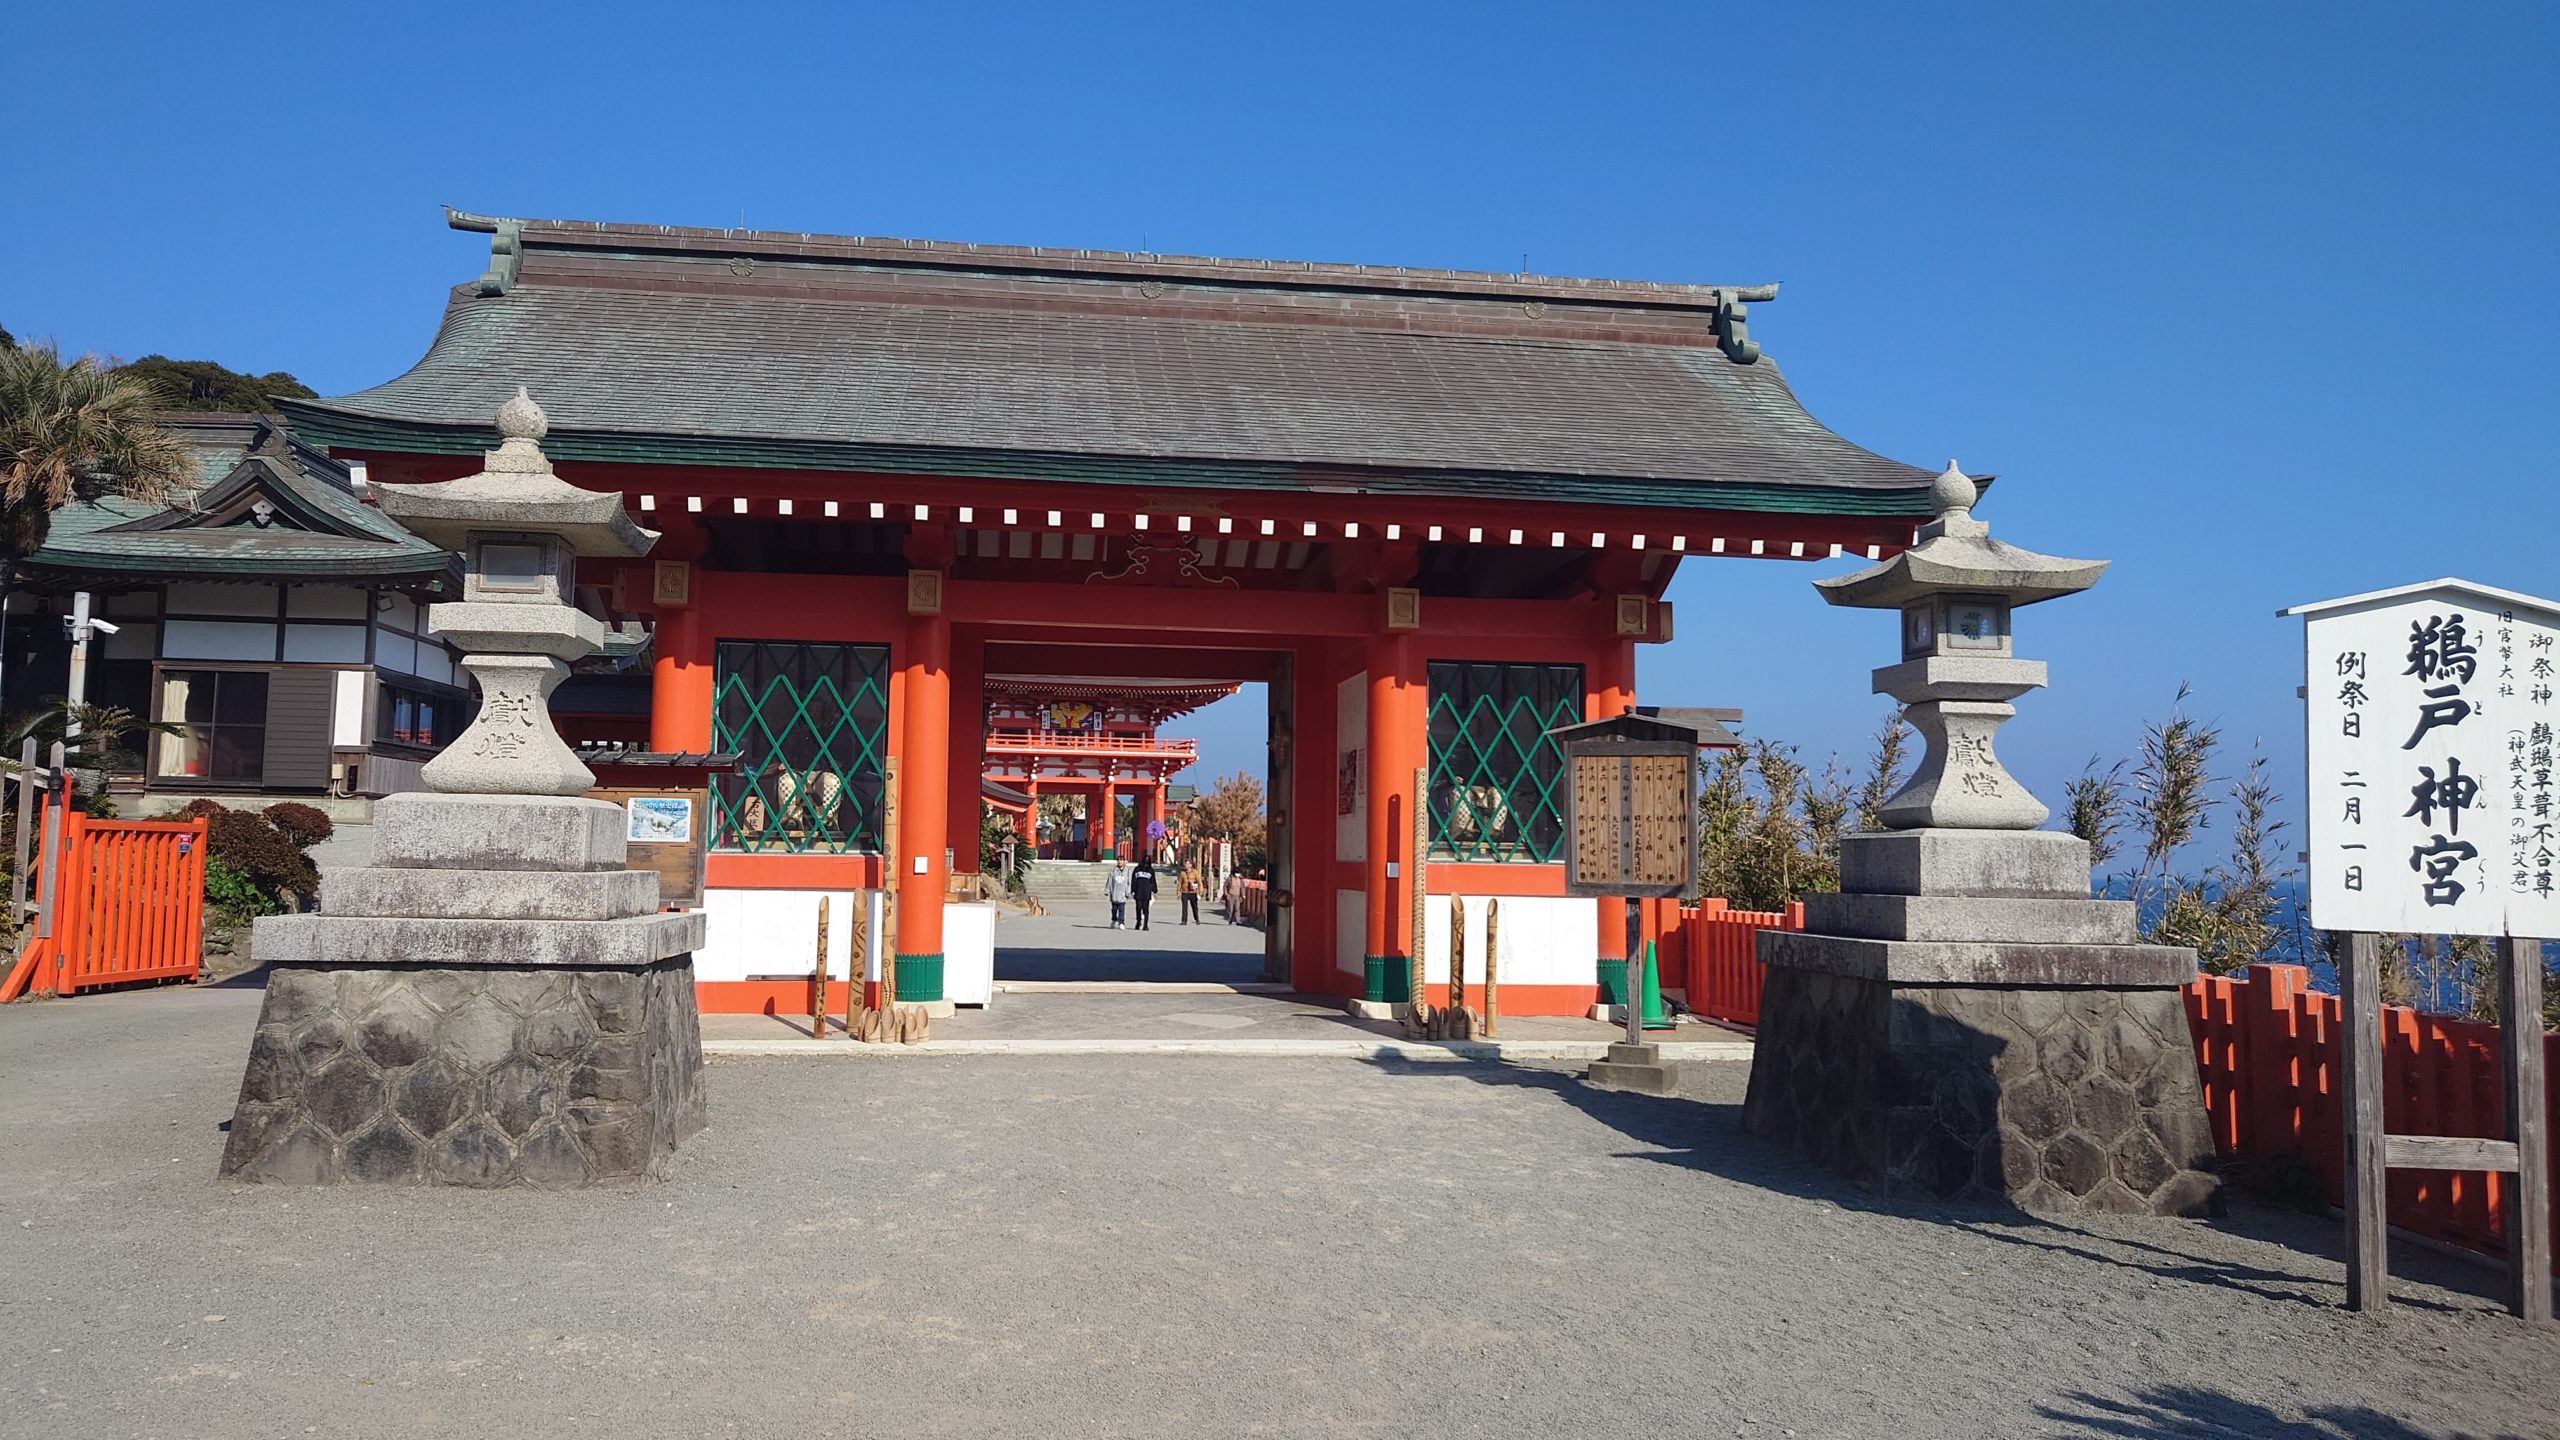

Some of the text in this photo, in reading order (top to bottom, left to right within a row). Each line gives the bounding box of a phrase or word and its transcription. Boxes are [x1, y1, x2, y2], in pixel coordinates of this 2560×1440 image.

[2336, 651, 2370, 892] 例祭日 二月一日
[2401, 612, 2479, 908] 鵜戸神宮
[2528, 633, 2555, 706] 御祭神
